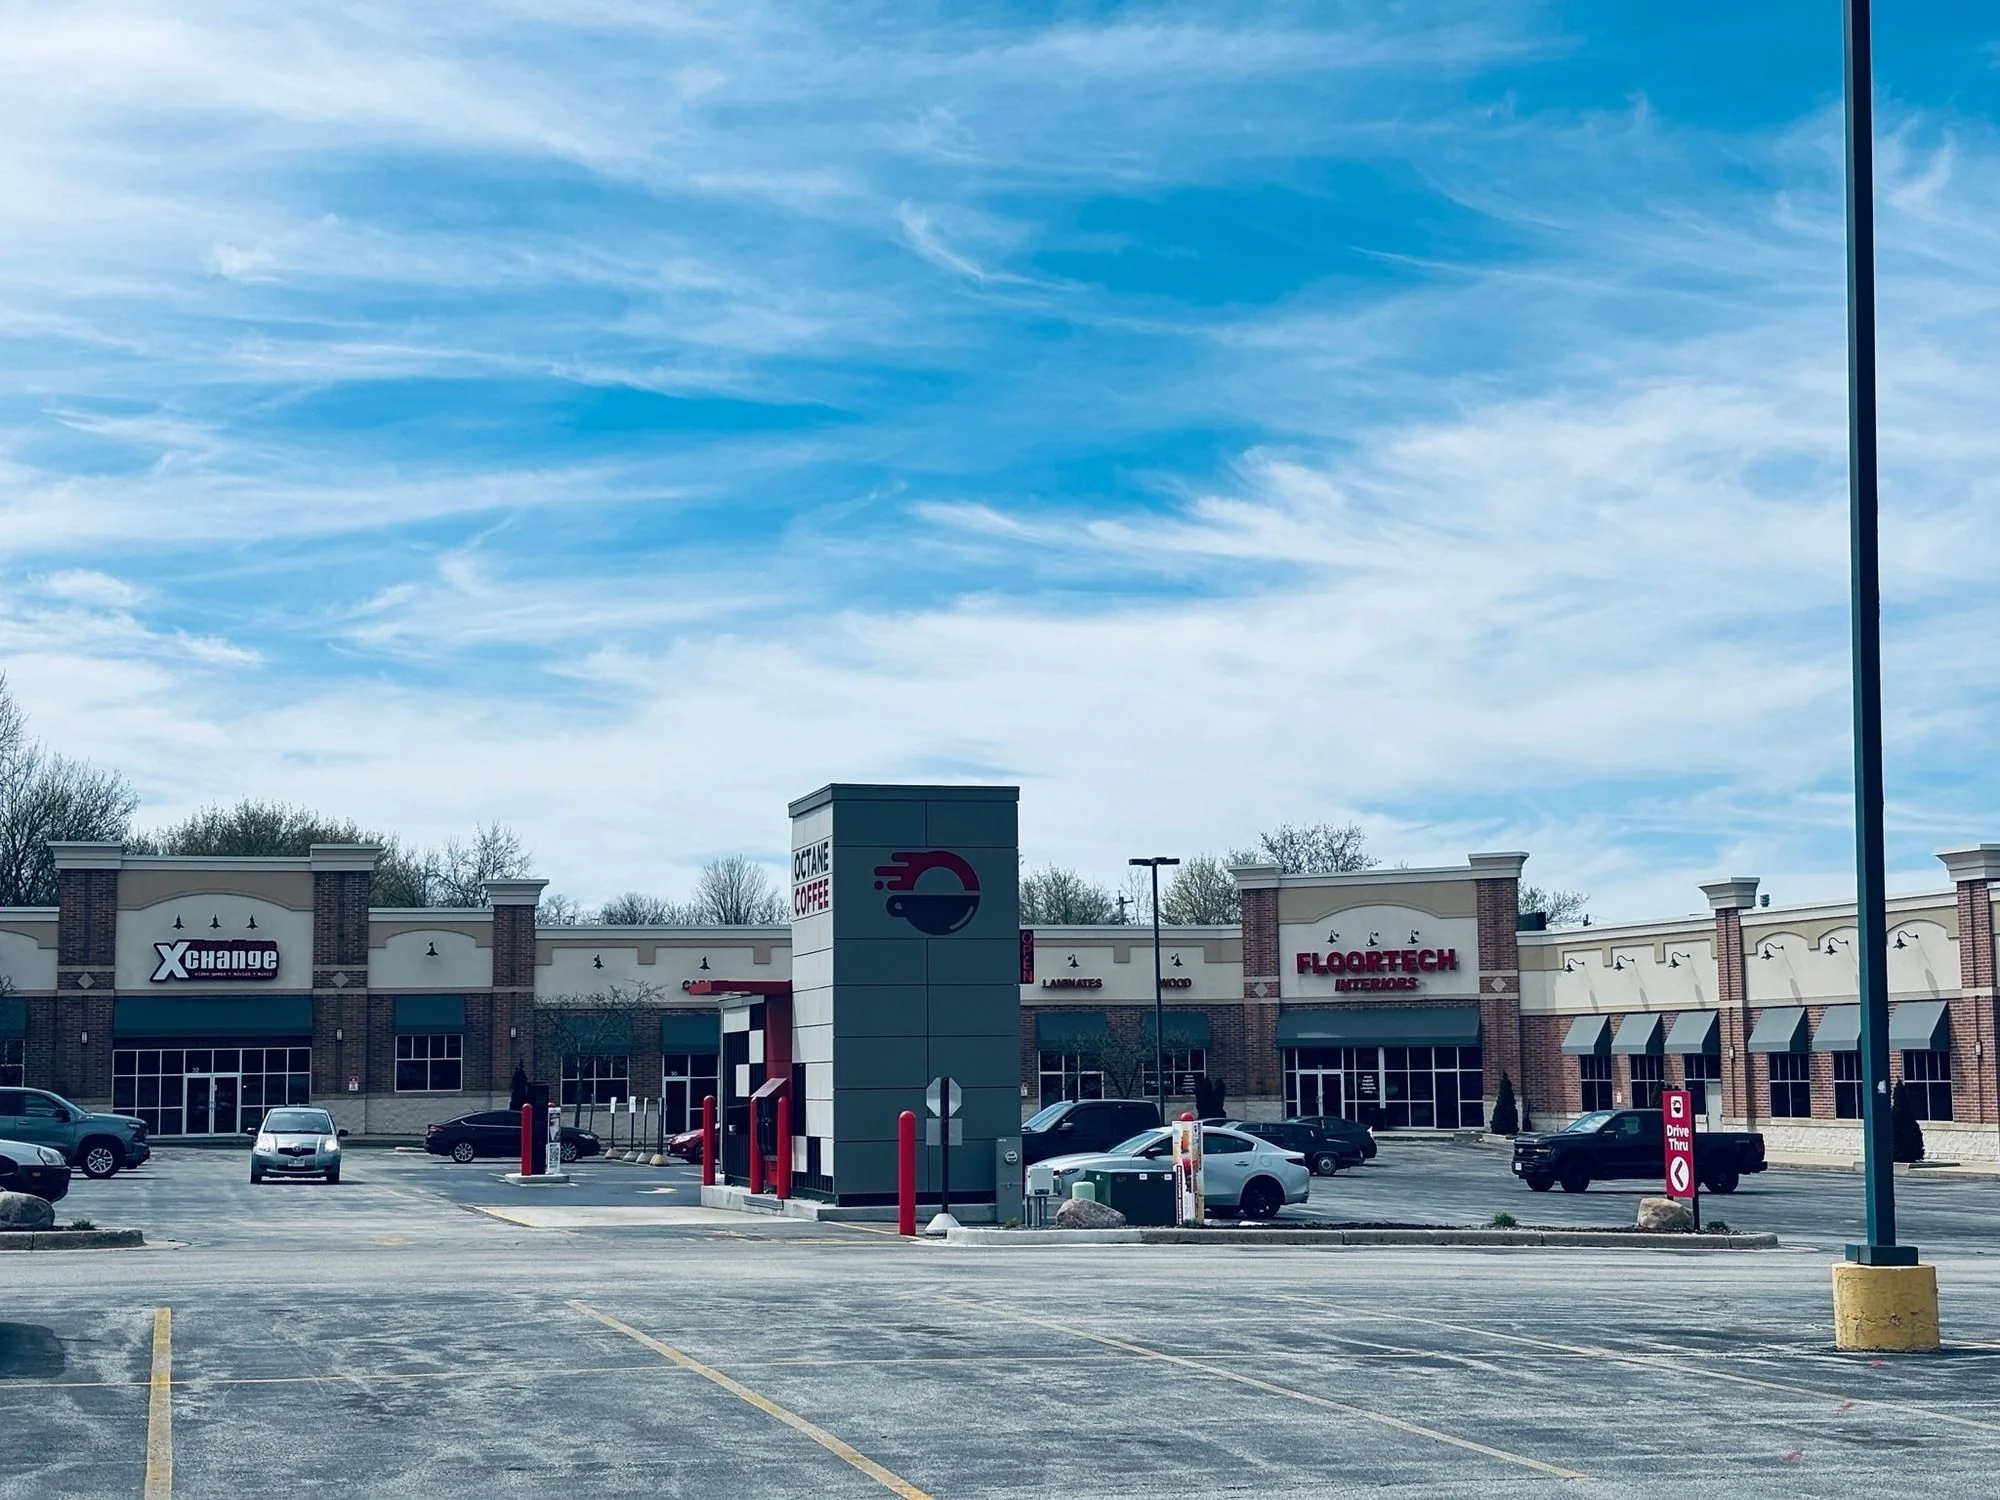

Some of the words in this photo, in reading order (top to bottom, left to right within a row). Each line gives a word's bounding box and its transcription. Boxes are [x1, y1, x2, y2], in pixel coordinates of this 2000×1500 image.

[794, 841, 829, 881] OCTANE
[794, 878, 829, 917] COFFEE
[1021, 931, 1033, 982] OPEN
[1296, 948, 1457, 975] FLOORTECH
[1042, 978, 1103, 988] LAMINATES
[1335, 977, 1419, 992] INTERIORS
[1666, 1124, 1689, 1137] Drive
[1668, 1138, 1689, 1151] Thru
